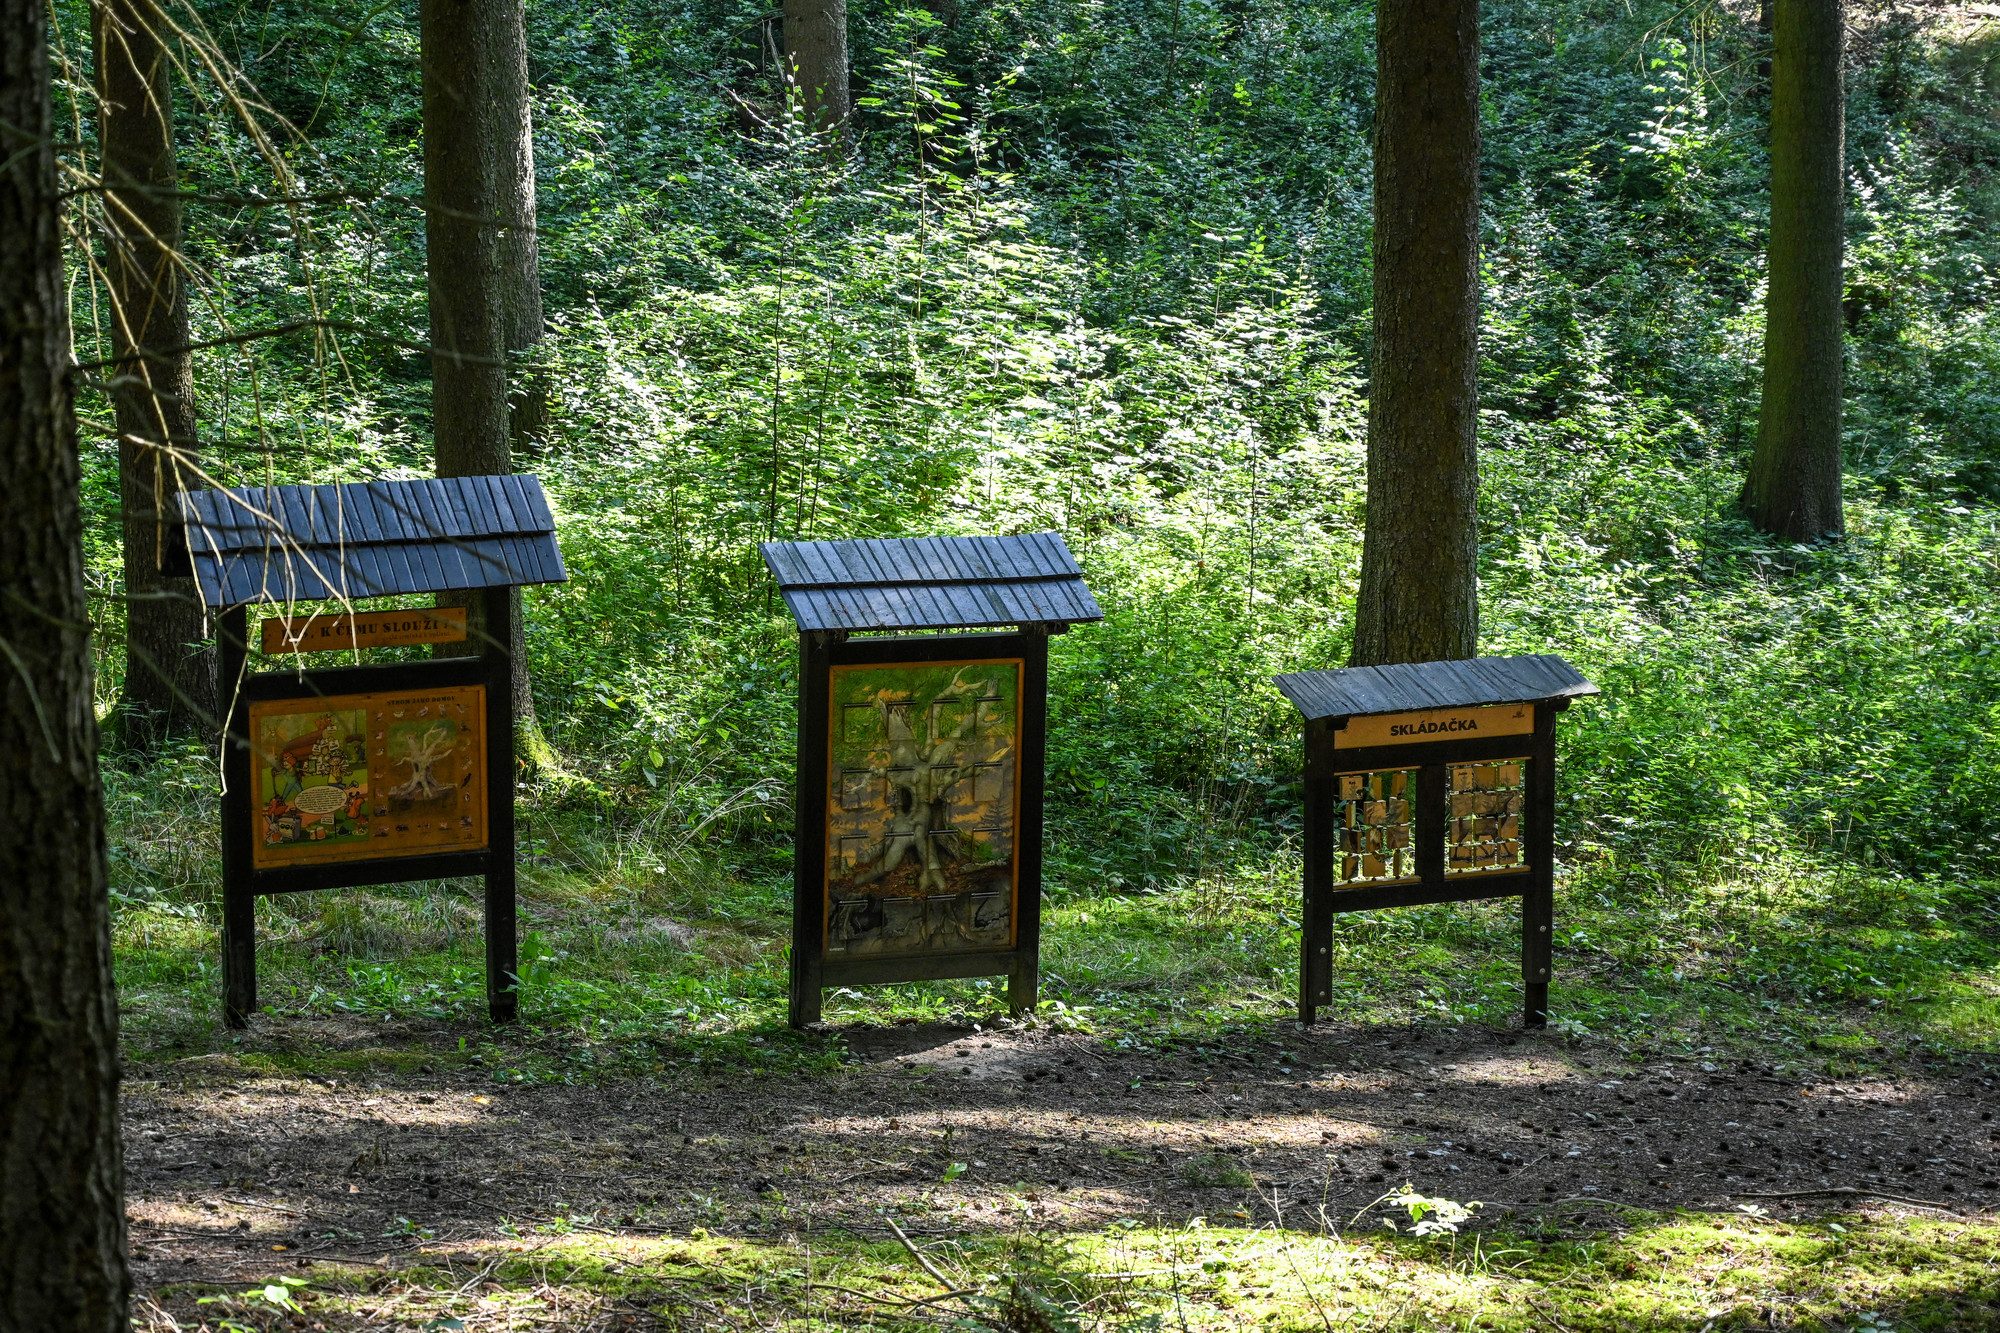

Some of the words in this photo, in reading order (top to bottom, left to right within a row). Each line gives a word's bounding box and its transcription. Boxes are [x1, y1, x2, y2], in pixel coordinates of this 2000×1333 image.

[320, 626, 332, 637] K
[336, 622, 378, 637] ČEMU
[431, 695, 456, 703] DOMOV
[1390, 718, 1478, 736] SKLÁDAČKA
